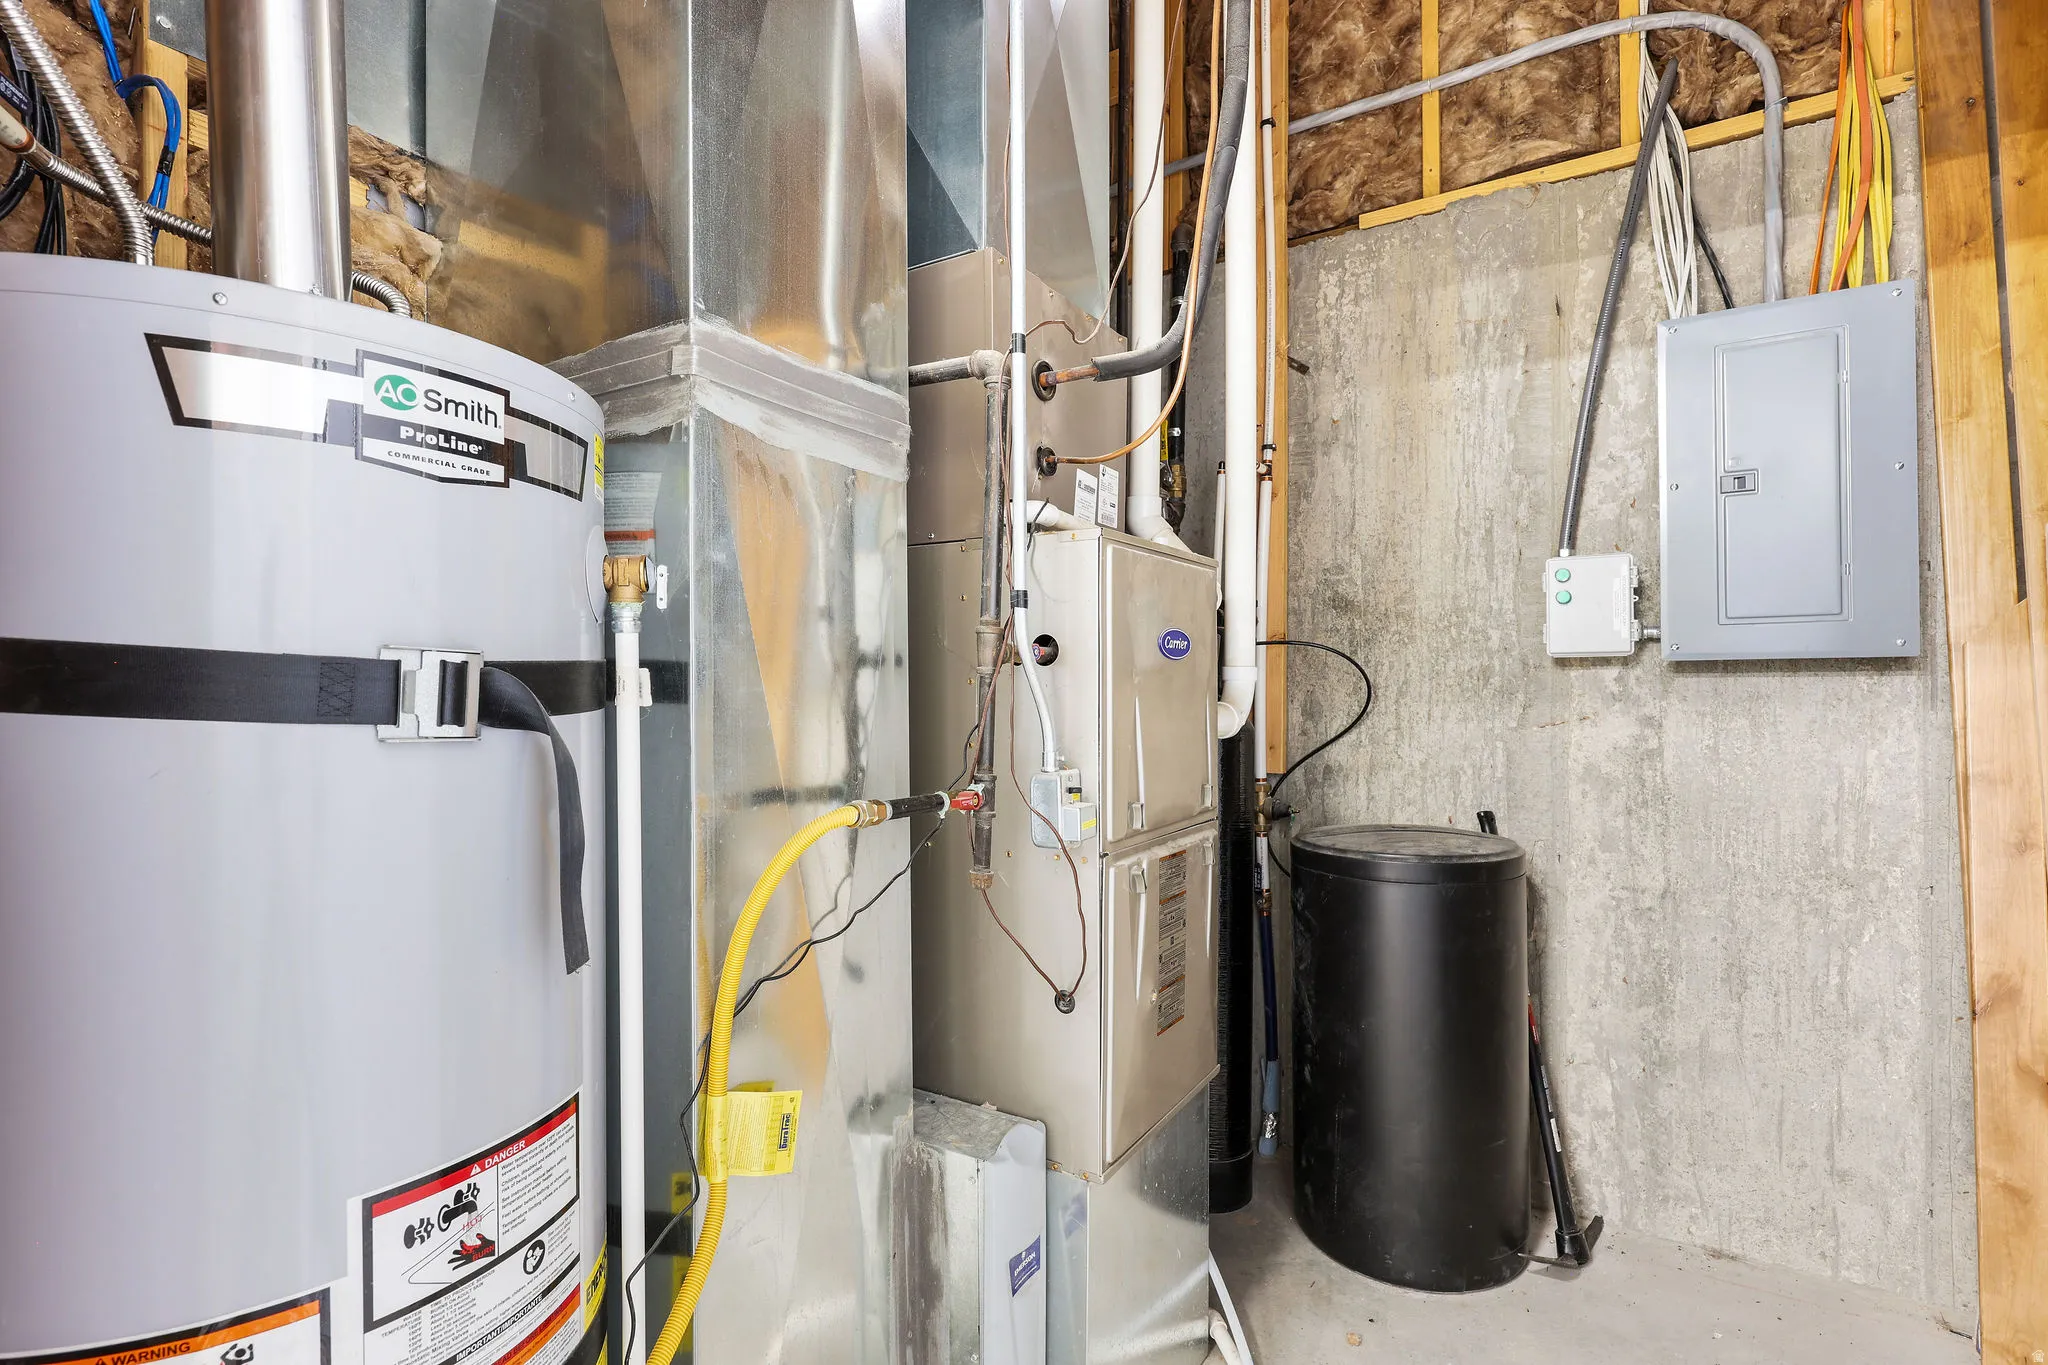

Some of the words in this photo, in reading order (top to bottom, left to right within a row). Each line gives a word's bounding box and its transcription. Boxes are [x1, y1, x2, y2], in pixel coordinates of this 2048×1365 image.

[375, 377, 419, 408] AO
[423, 389, 498, 428] Smith
[400, 425, 479, 454] ProLine
[387, 450, 457, 469] COMMERCIAL
[461, 464, 491, 476] GRADE
[1164, 636, 1188, 649] Carrier
[484, 1140, 526, 1169] DANGER
[472, 1245, 495, 1261] BURN
[111, 1342, 191, 1365] WARNING
